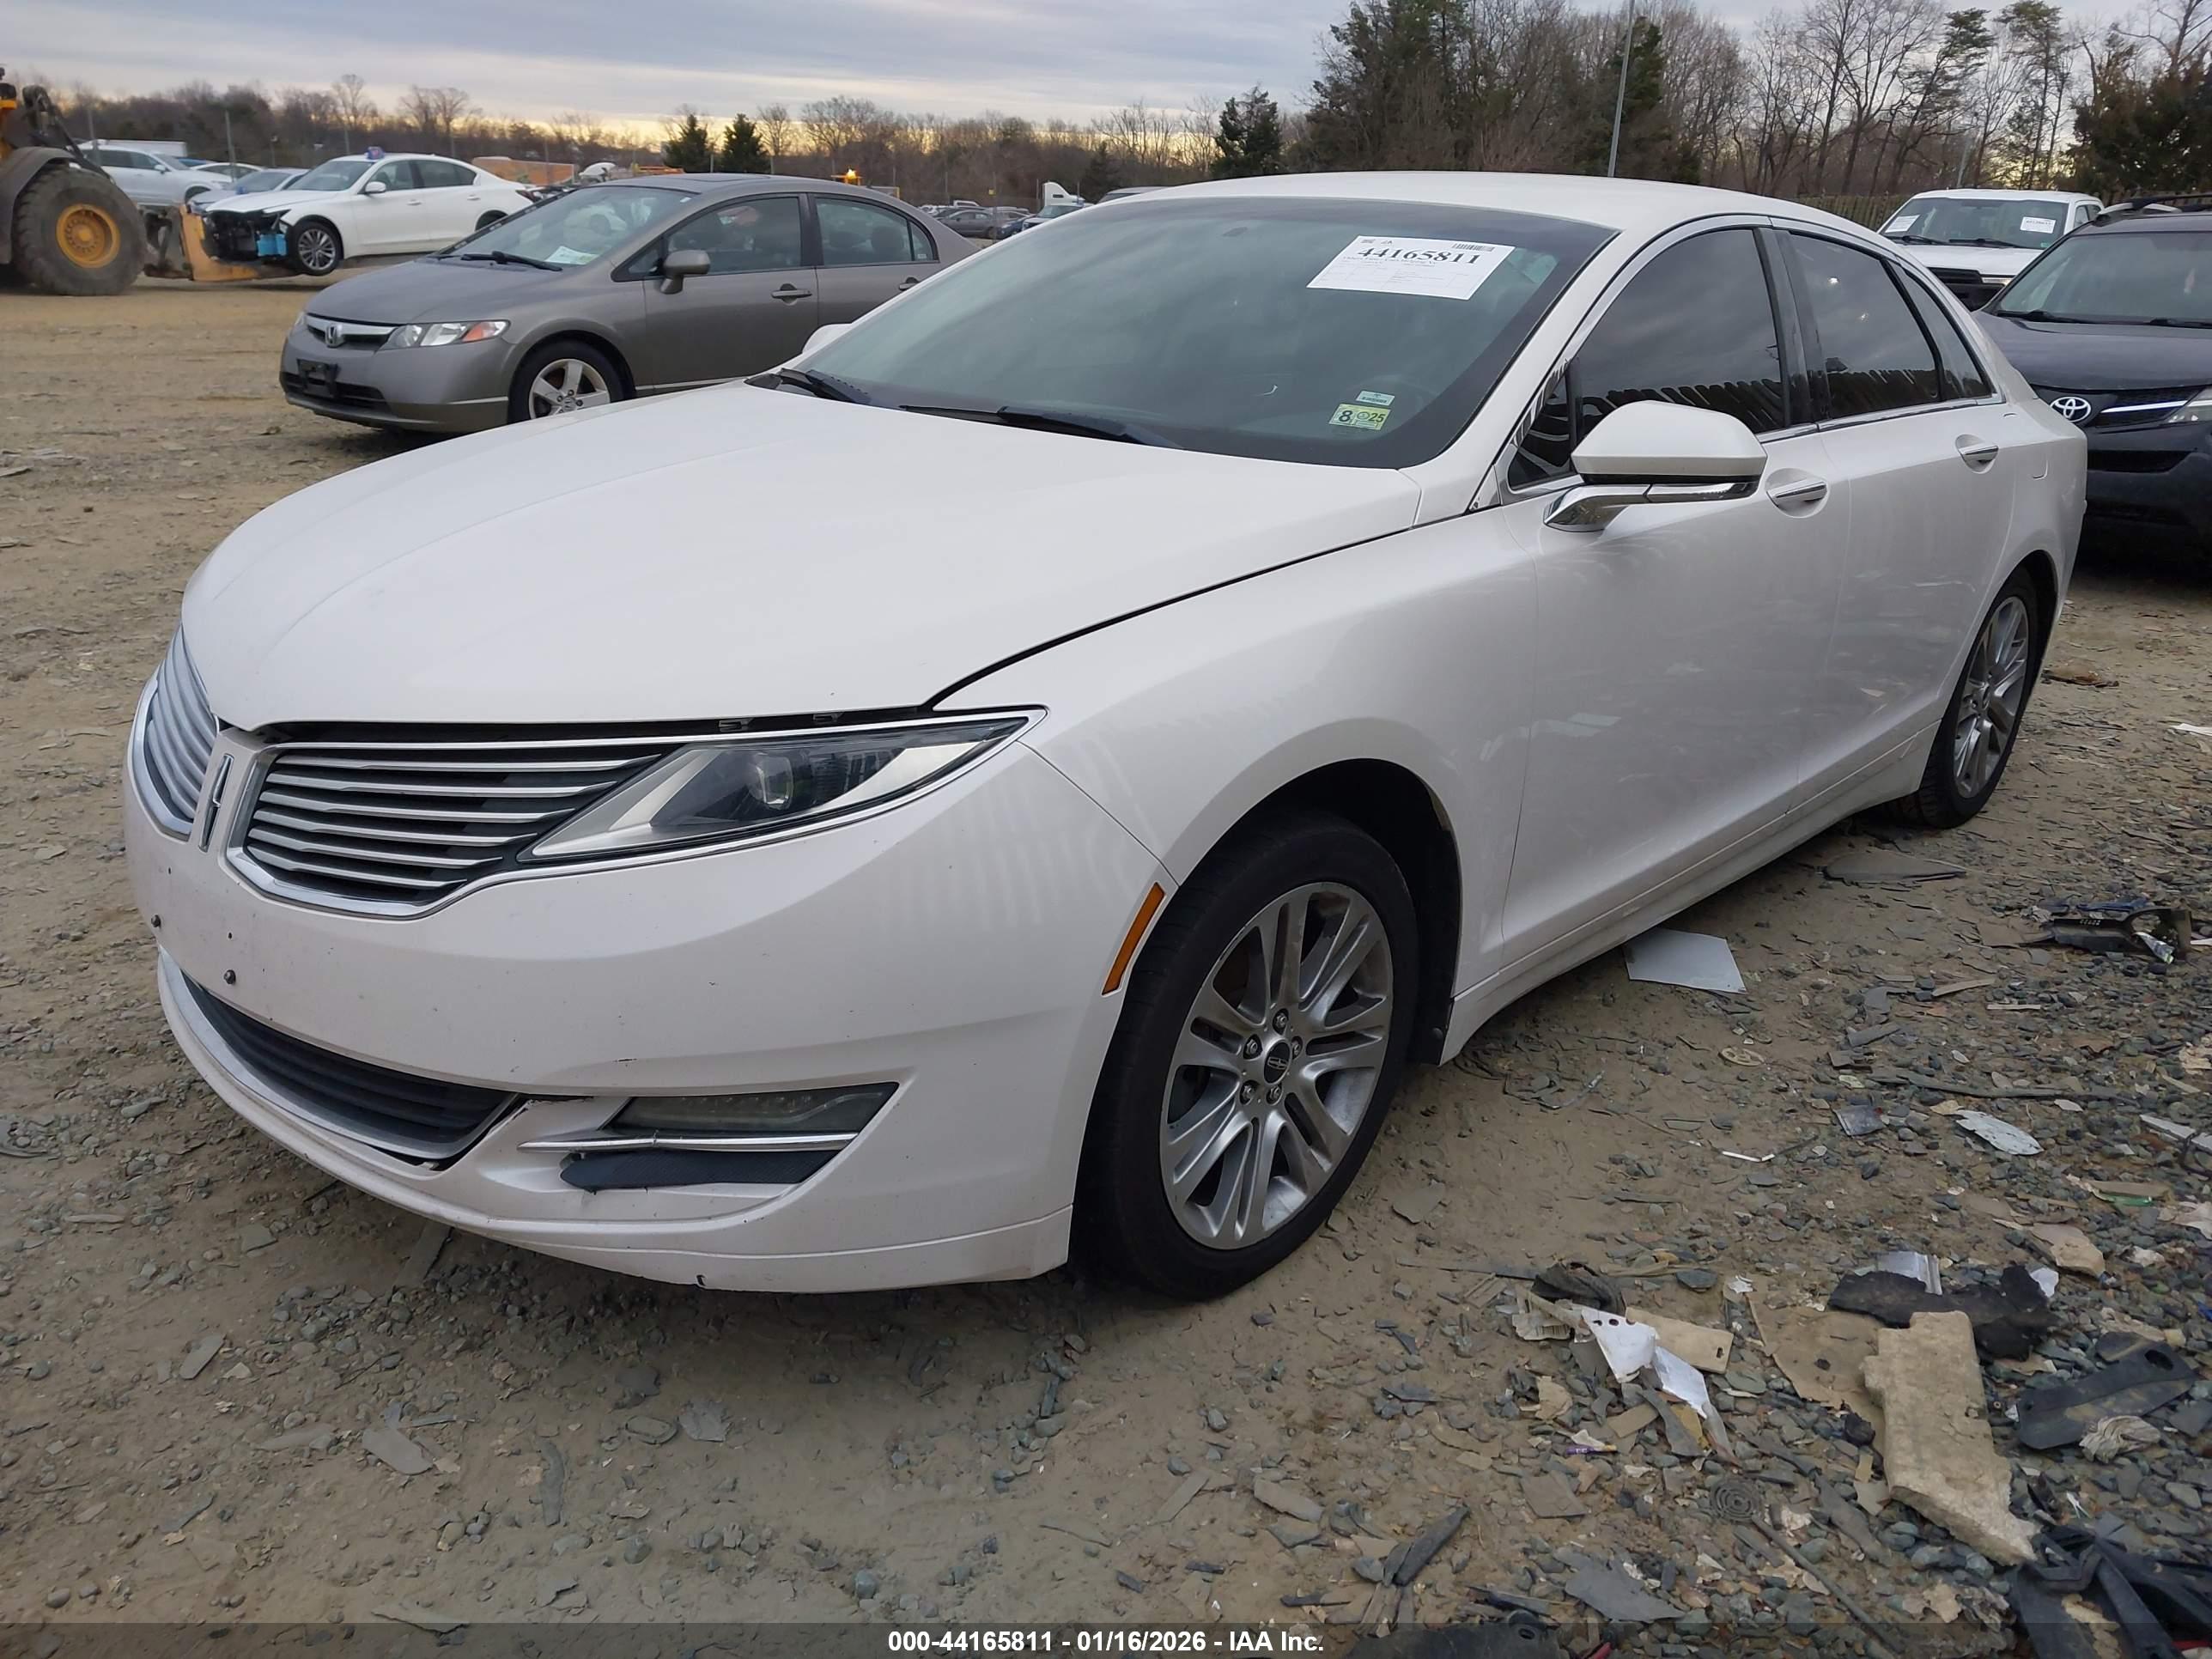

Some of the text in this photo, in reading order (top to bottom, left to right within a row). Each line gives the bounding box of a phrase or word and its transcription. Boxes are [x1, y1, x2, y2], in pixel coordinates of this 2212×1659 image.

[1358, 247, 1480, 264] 44165811
[1339, 410, 1386, 422] 8 25
